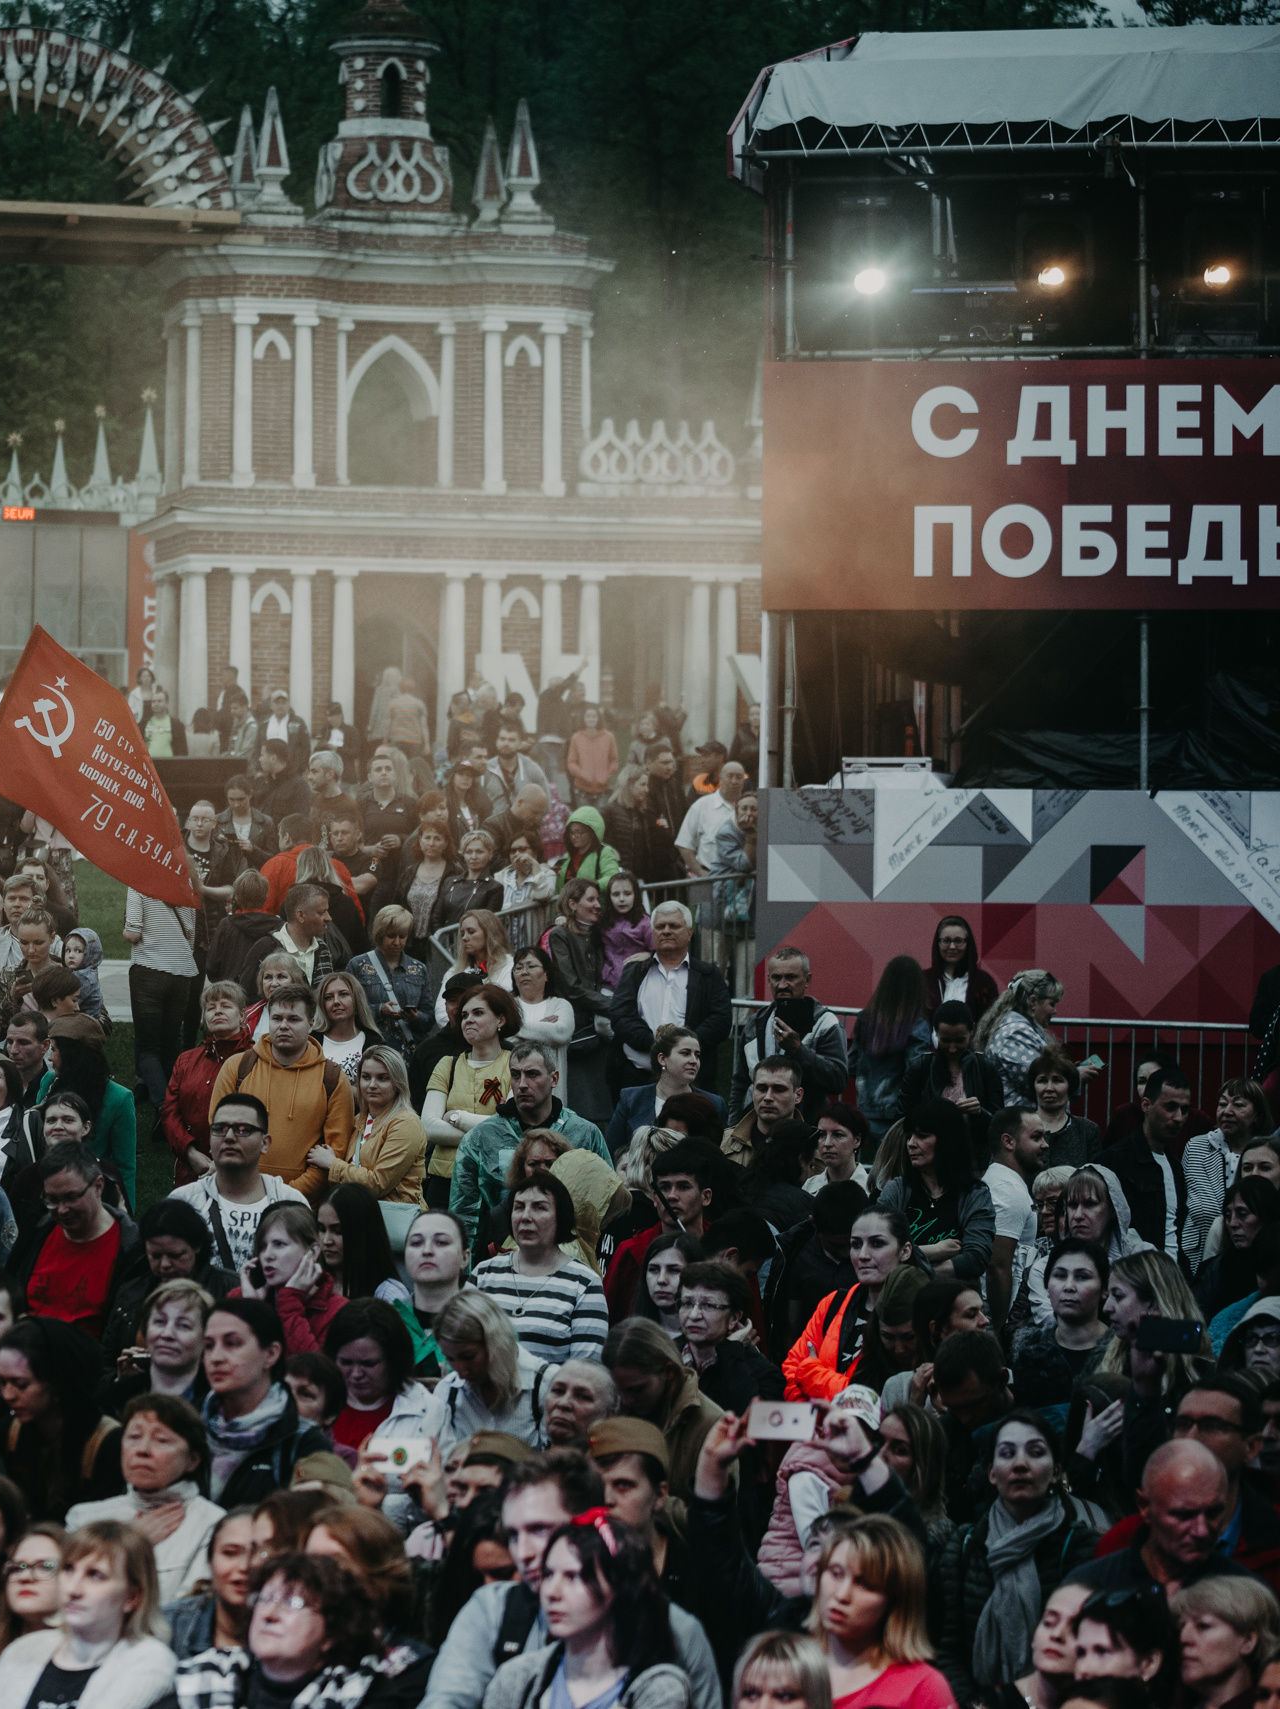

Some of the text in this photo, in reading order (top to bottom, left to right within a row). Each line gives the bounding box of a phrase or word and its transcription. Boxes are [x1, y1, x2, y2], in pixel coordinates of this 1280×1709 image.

[911, 384, 1280, 466] С ДНЕМ
[913, 503, 1280, 585] ПОБЕД
[93, 718, 116, 741] 150
[80, 793, 114, 831] 79
[228, 1210, 262, 1228] SPI
